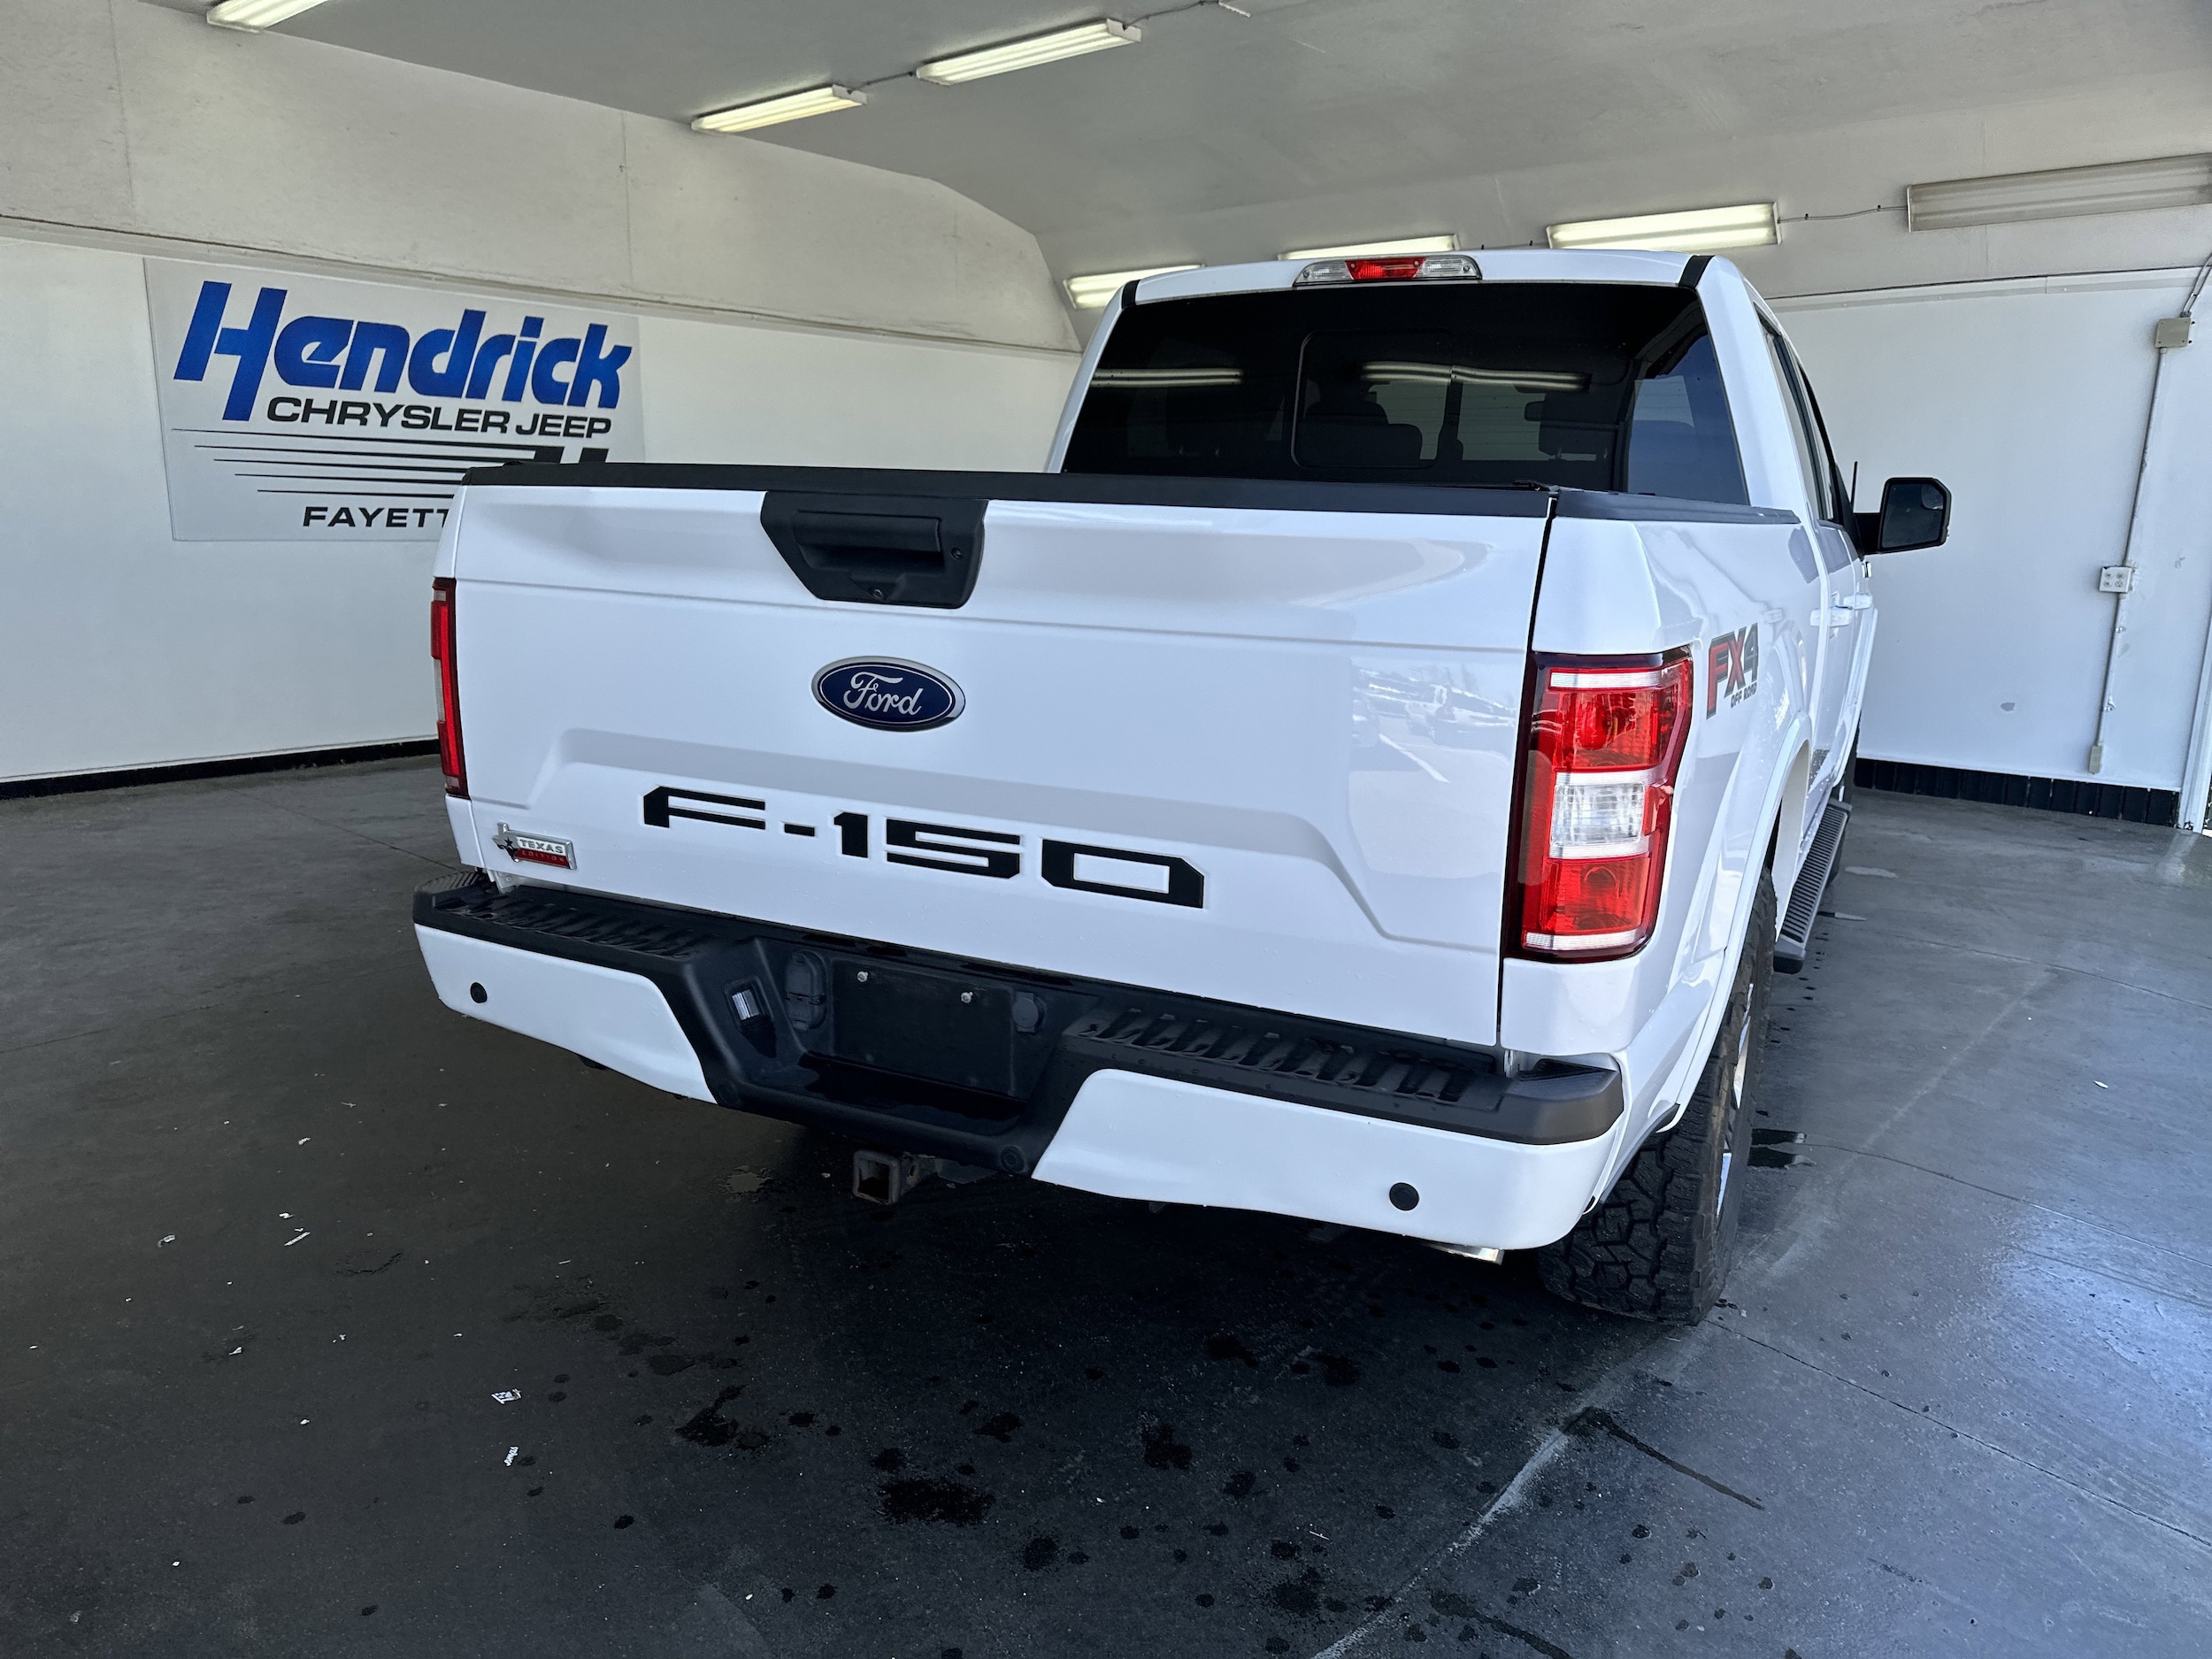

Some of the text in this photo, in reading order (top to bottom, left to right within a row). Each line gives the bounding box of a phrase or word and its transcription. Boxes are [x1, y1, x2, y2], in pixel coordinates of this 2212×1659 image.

[173, 280, 633, 421] Hendrick
[266, 396, 612, 439] CHRYSLER JEEP
[1706, 622, 1759, 720] FX4
[843, 672, 924, 715] Ford
[1731, 689, 1742, 708] OFF
[519, 839, 565, 854] TEXAS
[521, 849, 565, 863] EDITION
[643, 786, 1205, 909] F-150
